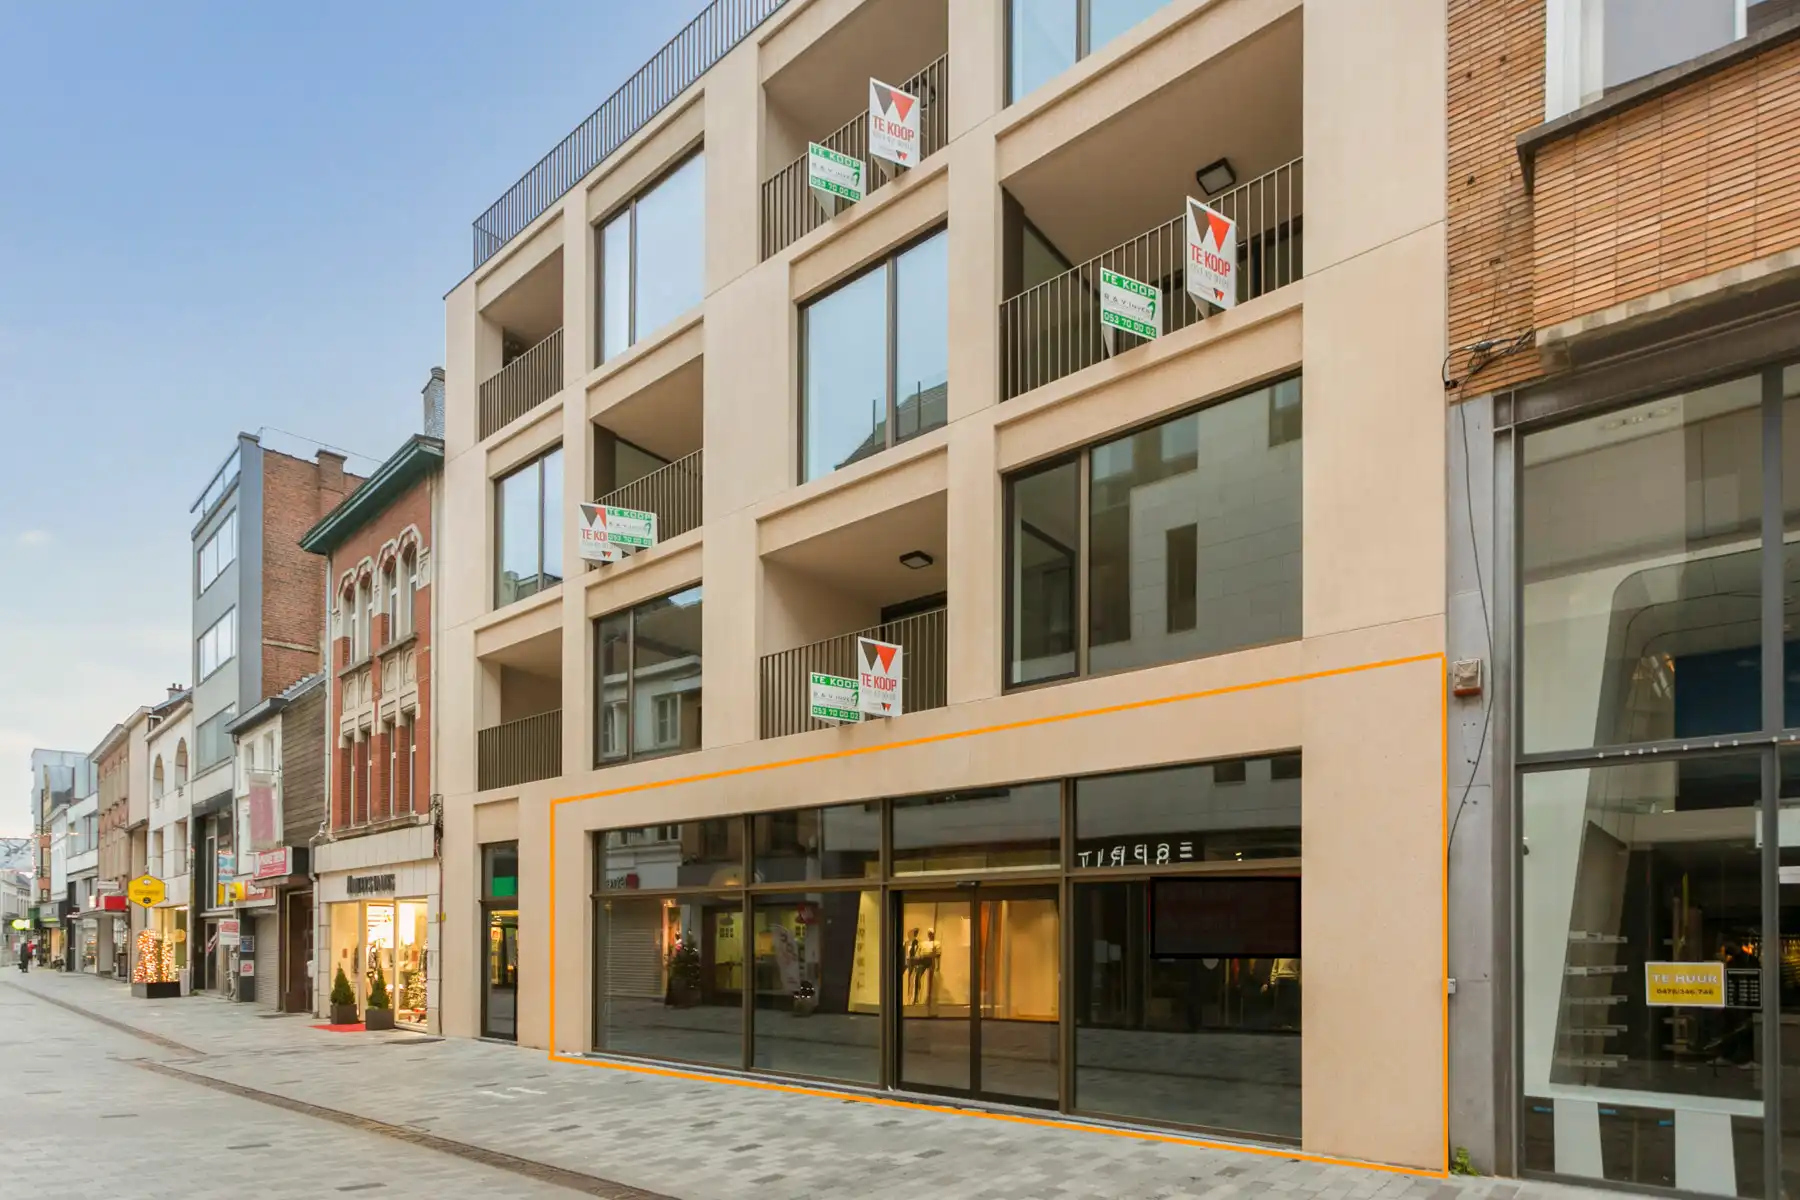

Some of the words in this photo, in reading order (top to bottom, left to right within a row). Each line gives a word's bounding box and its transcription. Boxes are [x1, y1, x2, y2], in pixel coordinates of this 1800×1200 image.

[873, 116, 885, 131] TE
[887, 121, 915, 141] KOOP
[811, 144, 825, 156] TE
[829, 150, 860, 168] KOOP
[1190, 243, 1203, 264] TE
[1204, 250, 1231, 277] KOOP
[1104, 272, 1118, 285] TE
[1121, 279, 1156, 298] KOOP
[1104, 311, 1119, 324] 053
[1121, 318, 1132, 328] 70
[1134, 322, 1144, 332] 00
[1146, 326, 1156, 336] 02
[581, 528, 592, 540] TE
[813, 674, 826, 684] TE
[829, 677, 859, 689] KOOP
[861, 672, 872, 687] TE
[874, 676, 897, 692] KOOP
[1653, 974, 1670, 984] TE
[1675, 974, 1718, 984] HUUR
